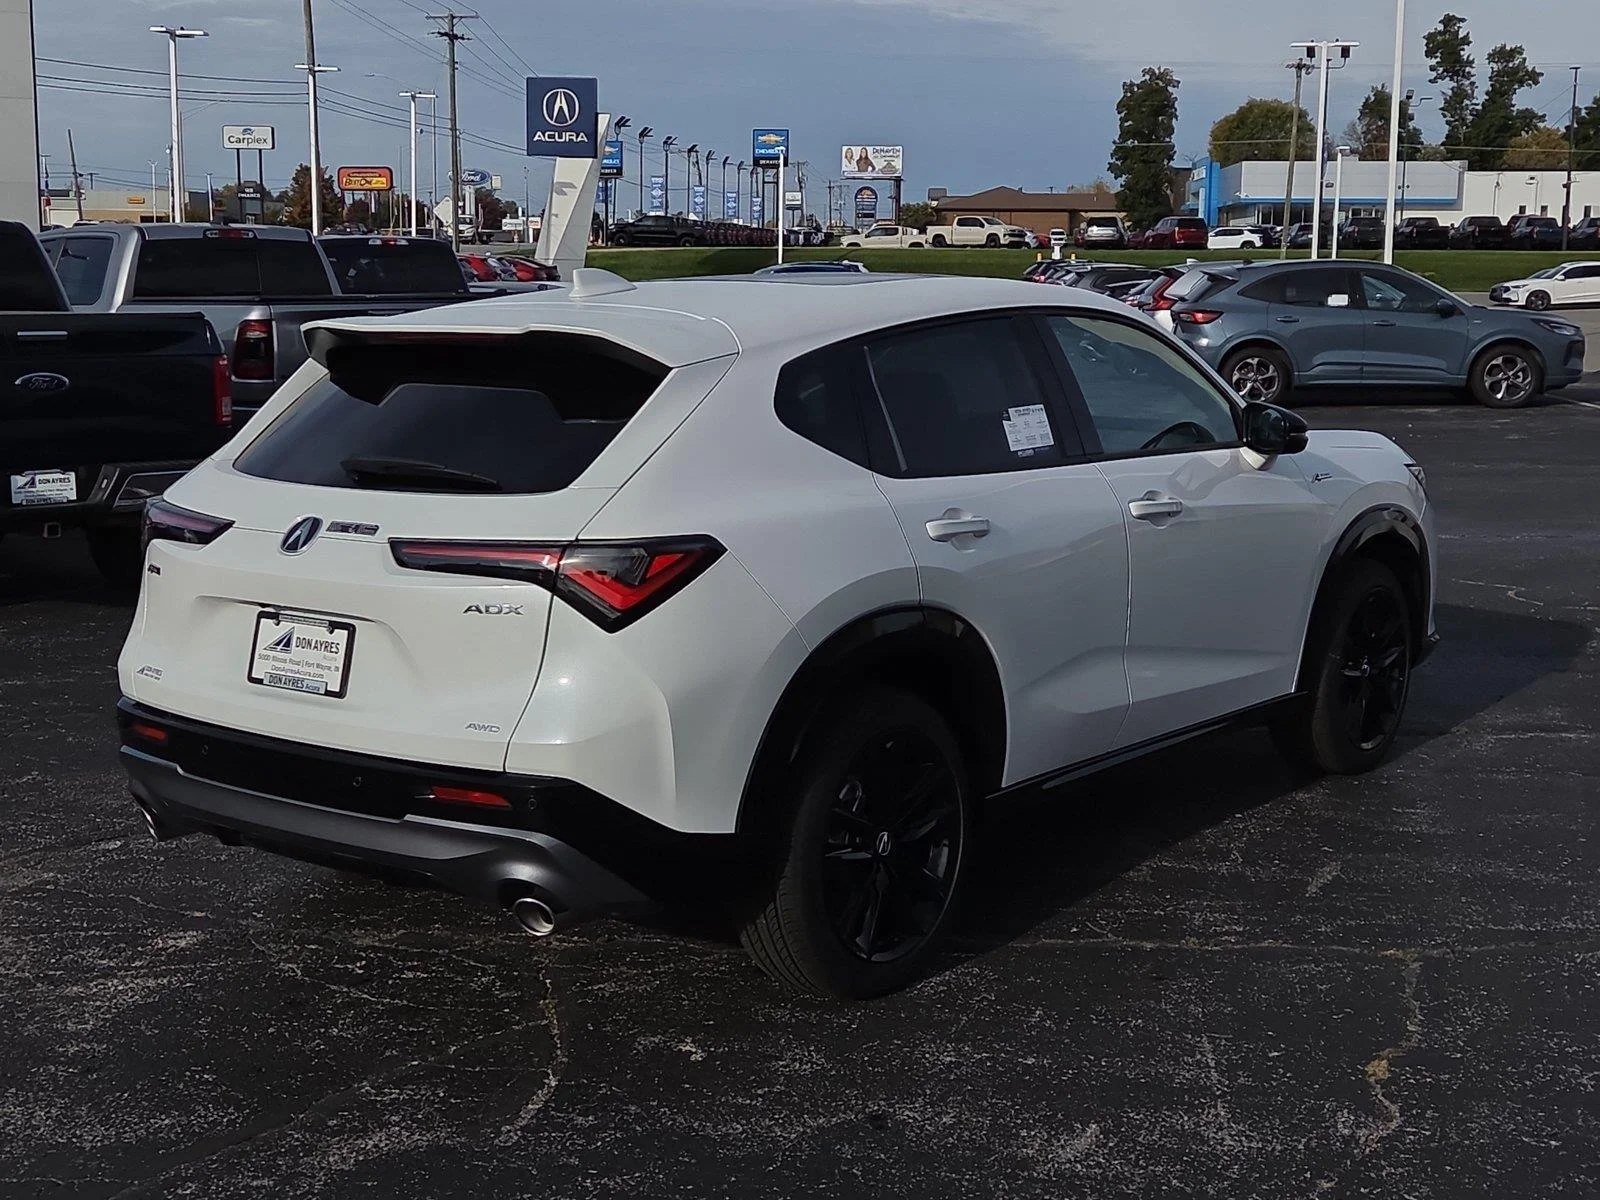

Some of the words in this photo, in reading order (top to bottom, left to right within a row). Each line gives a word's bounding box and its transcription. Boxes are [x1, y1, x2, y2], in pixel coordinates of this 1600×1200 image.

[227, 135, 268, 147] Carplex
[533, 131, 588, 142] ACURA
[461, 171, 481, 182] Ford
[51, 476, 71, 484] AYRES
[463, 604, 524, 615] ADX
[295, 636, 313, 650] DON
[313, 639, 340, 655] AYRES
[305, 661, 315, 669] Fort
[270, 664, 325, 679] DonAyresAcura.com
[268, 674, 282, 686] DON
[283, 677, 305, 689] AYRES
[305, 683, 320, 692] Acura
[465, 723, 500, 733] AWD
